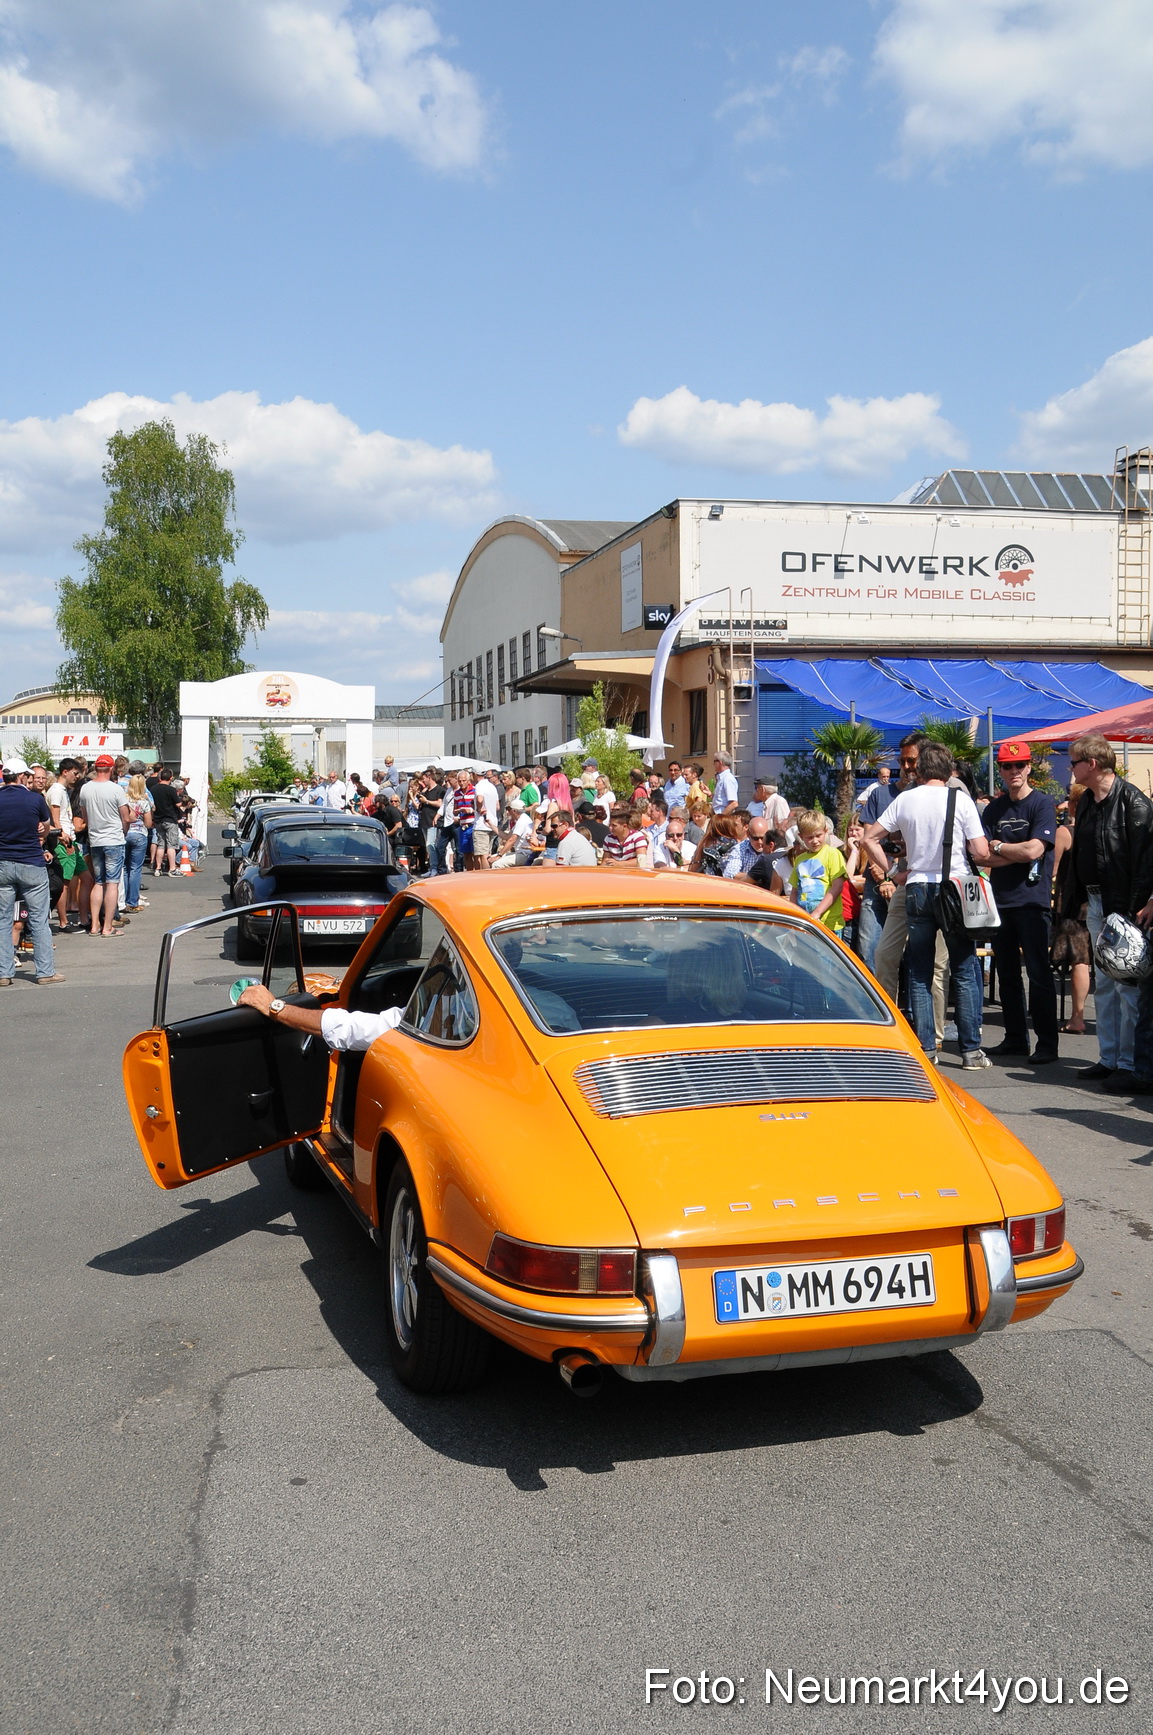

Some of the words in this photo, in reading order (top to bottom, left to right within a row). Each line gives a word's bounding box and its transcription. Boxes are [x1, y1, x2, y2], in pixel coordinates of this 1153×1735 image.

[781, 551, 991, 577] OFENWERK
[781, 585, 860, 599] ZENTRUM
[904, 587, 964, 600] MOBILE
[970, 588, 1036, 602] CLASSIC
[648, 610, 671, 624] sky
[62, 735, 110, 746] FAT
[965, 882, 980, 901] 130
[307, 921, 315, 930] N
[322, 921, 338, 930] VU
[343, 921, 363, 930] 572
[683, 1188, 960, 1217] PORSCHE
[741, 1275, 765, 1313] N
[787, 1270, 835, 1309] MM
[843, 1261, 931, 1304] 694H
[724, 1302, 733, 1312] D
